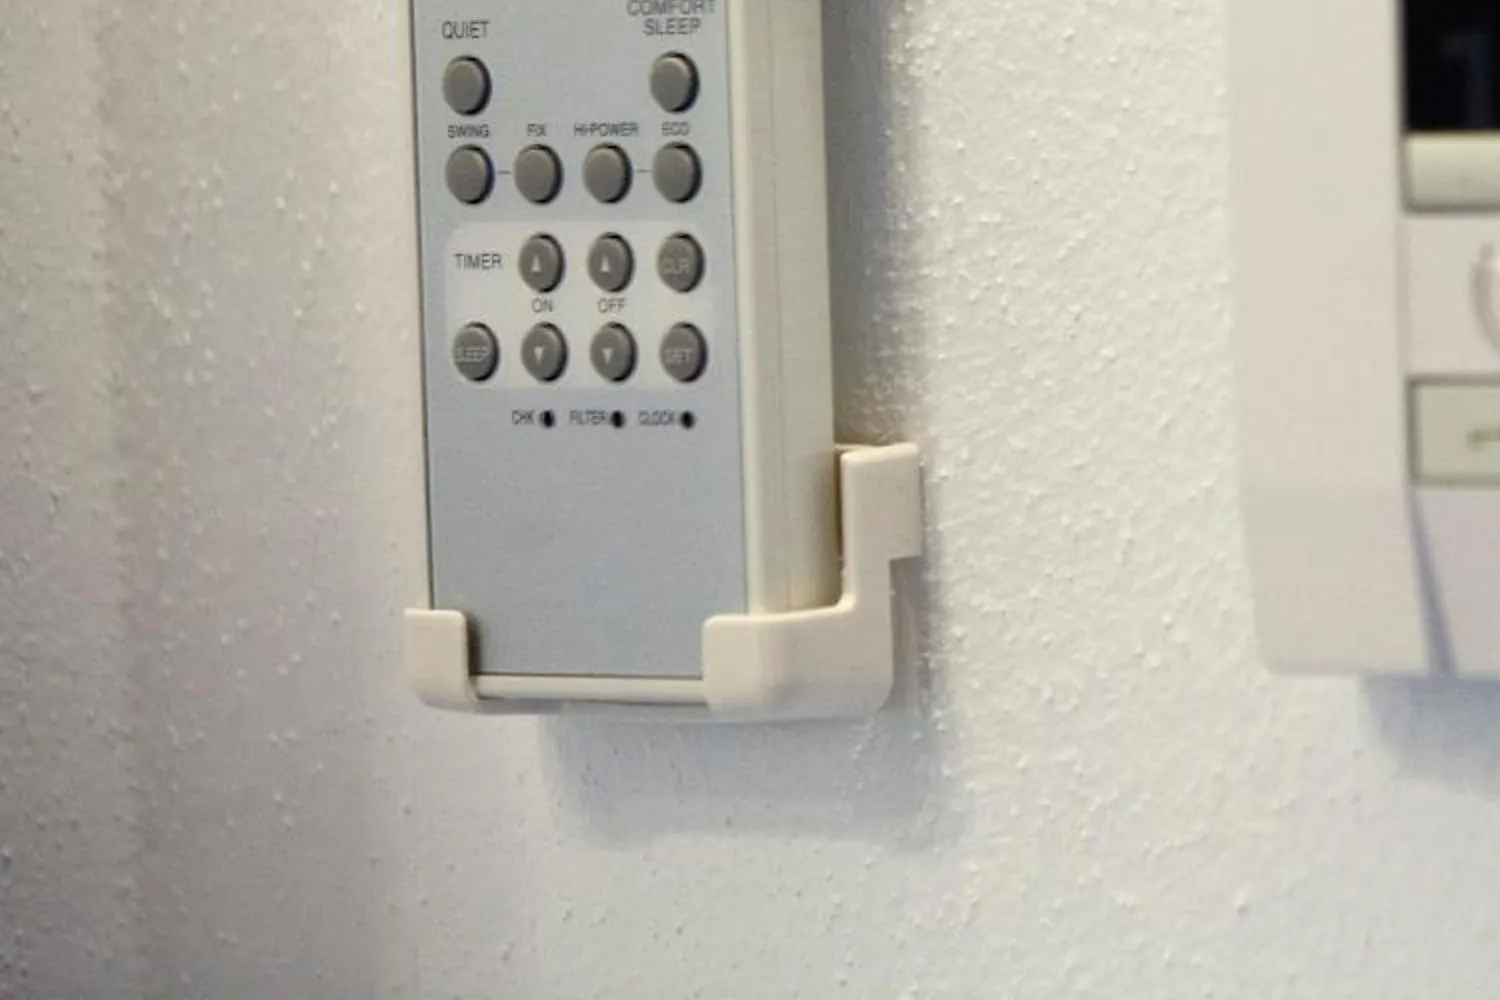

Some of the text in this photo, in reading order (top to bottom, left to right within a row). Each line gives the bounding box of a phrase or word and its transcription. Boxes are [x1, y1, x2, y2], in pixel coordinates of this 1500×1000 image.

[442, 20, 489, 39] QUIET
[644, 17, 701, 36] SLEEP
[1441, 28, 1496, 125] 1
[447, 124, 490, 138] SWING
[527, 124, 547, 137] FIX
[574, 122, 639, 137] HI-POWER
[661, 121, 689, 136] ECO
[455, 253, 502, 271] TIMER
[531, 298, 553, 313] ON
[597, 298, 626, 313] OFF
[569, 409, 608, 425] FILTER
